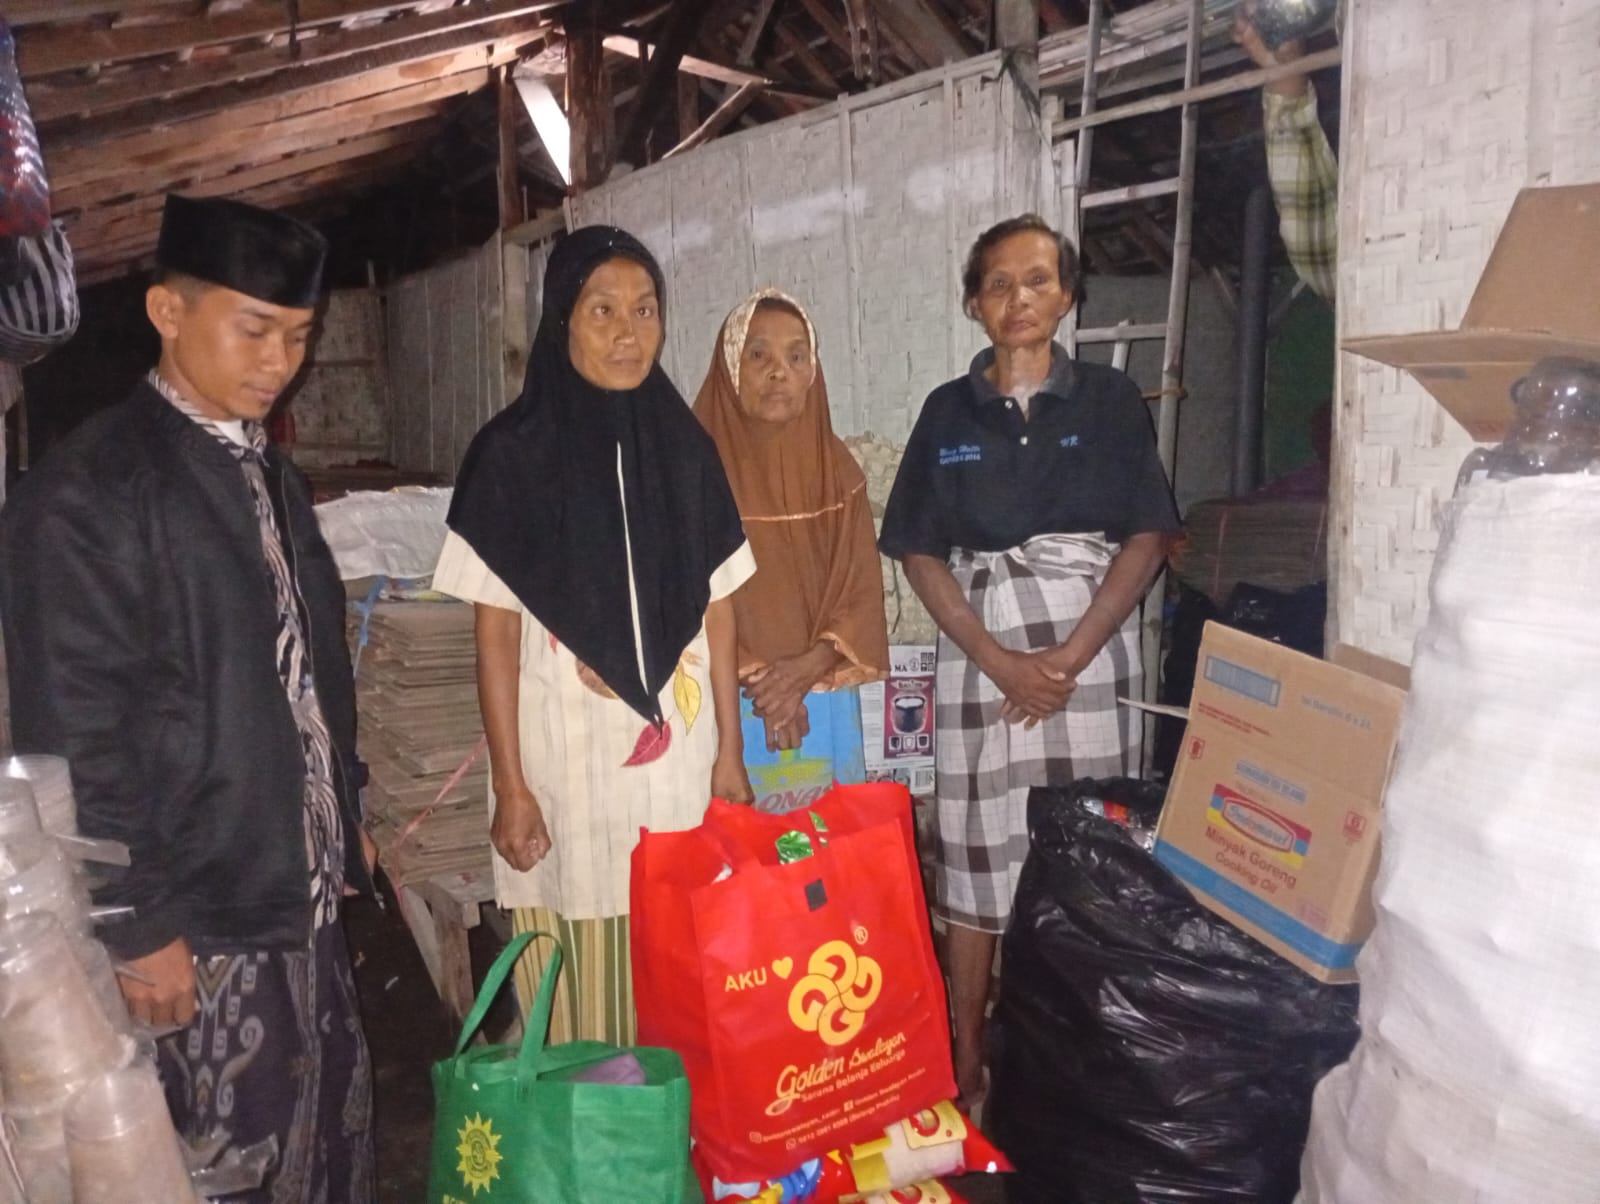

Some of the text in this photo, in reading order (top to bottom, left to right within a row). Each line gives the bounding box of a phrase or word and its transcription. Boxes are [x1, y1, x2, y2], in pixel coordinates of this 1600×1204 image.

[1205, 826, 1297, 890] Minyak Goreng
[1215, 852, 1279, 895] Cooking Oil
[725, 967, 767, 992] AKU
[765, 1057, 845, 1117] Golden
[836, 1069, 869, 1089] Belanja
